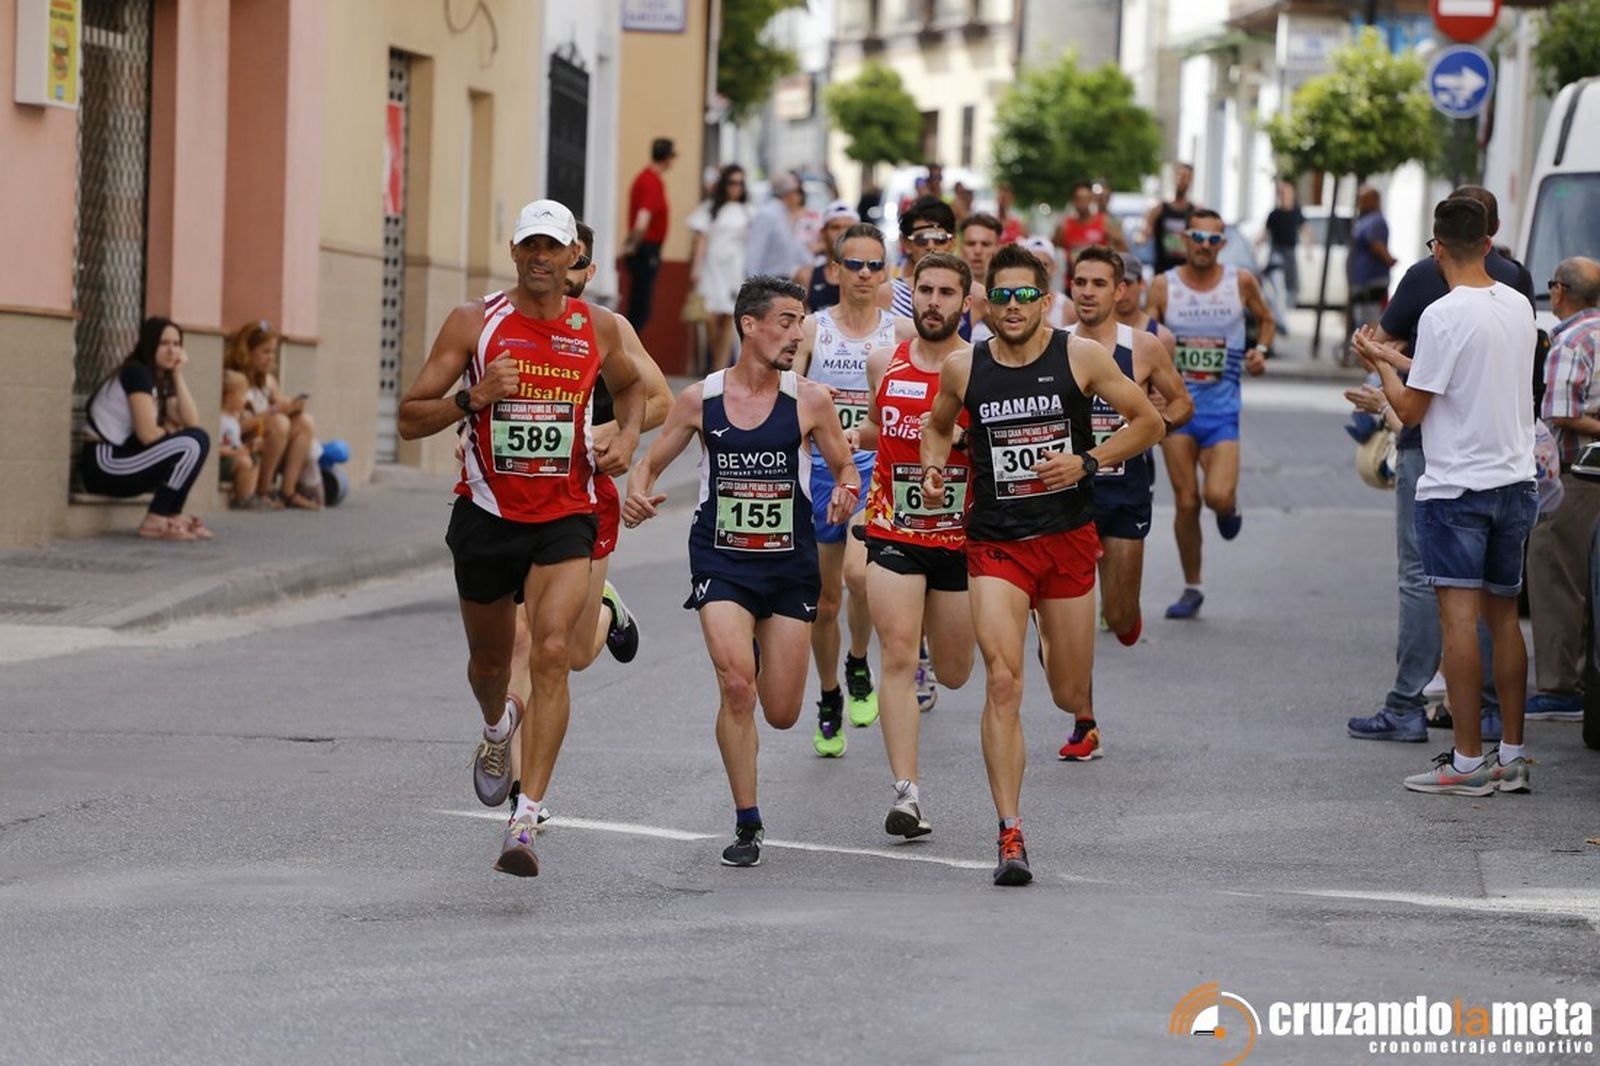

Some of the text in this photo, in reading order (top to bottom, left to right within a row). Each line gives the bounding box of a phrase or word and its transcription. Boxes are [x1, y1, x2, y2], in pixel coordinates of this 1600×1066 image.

[823, 359, 866, 370] MARAC
[1178, 350, 1224, 368] 1052
[519, 382, 584, 405] lisalud
[979, 394, 1063, 419] GRANADA
[839, 408, 868, 430] 05
[508, 425, 562, 452] 589
[717, 451, 787, 469] BEWOR
[906, 485, 955, 509] 66
[731, 502, 782, 528] 155
